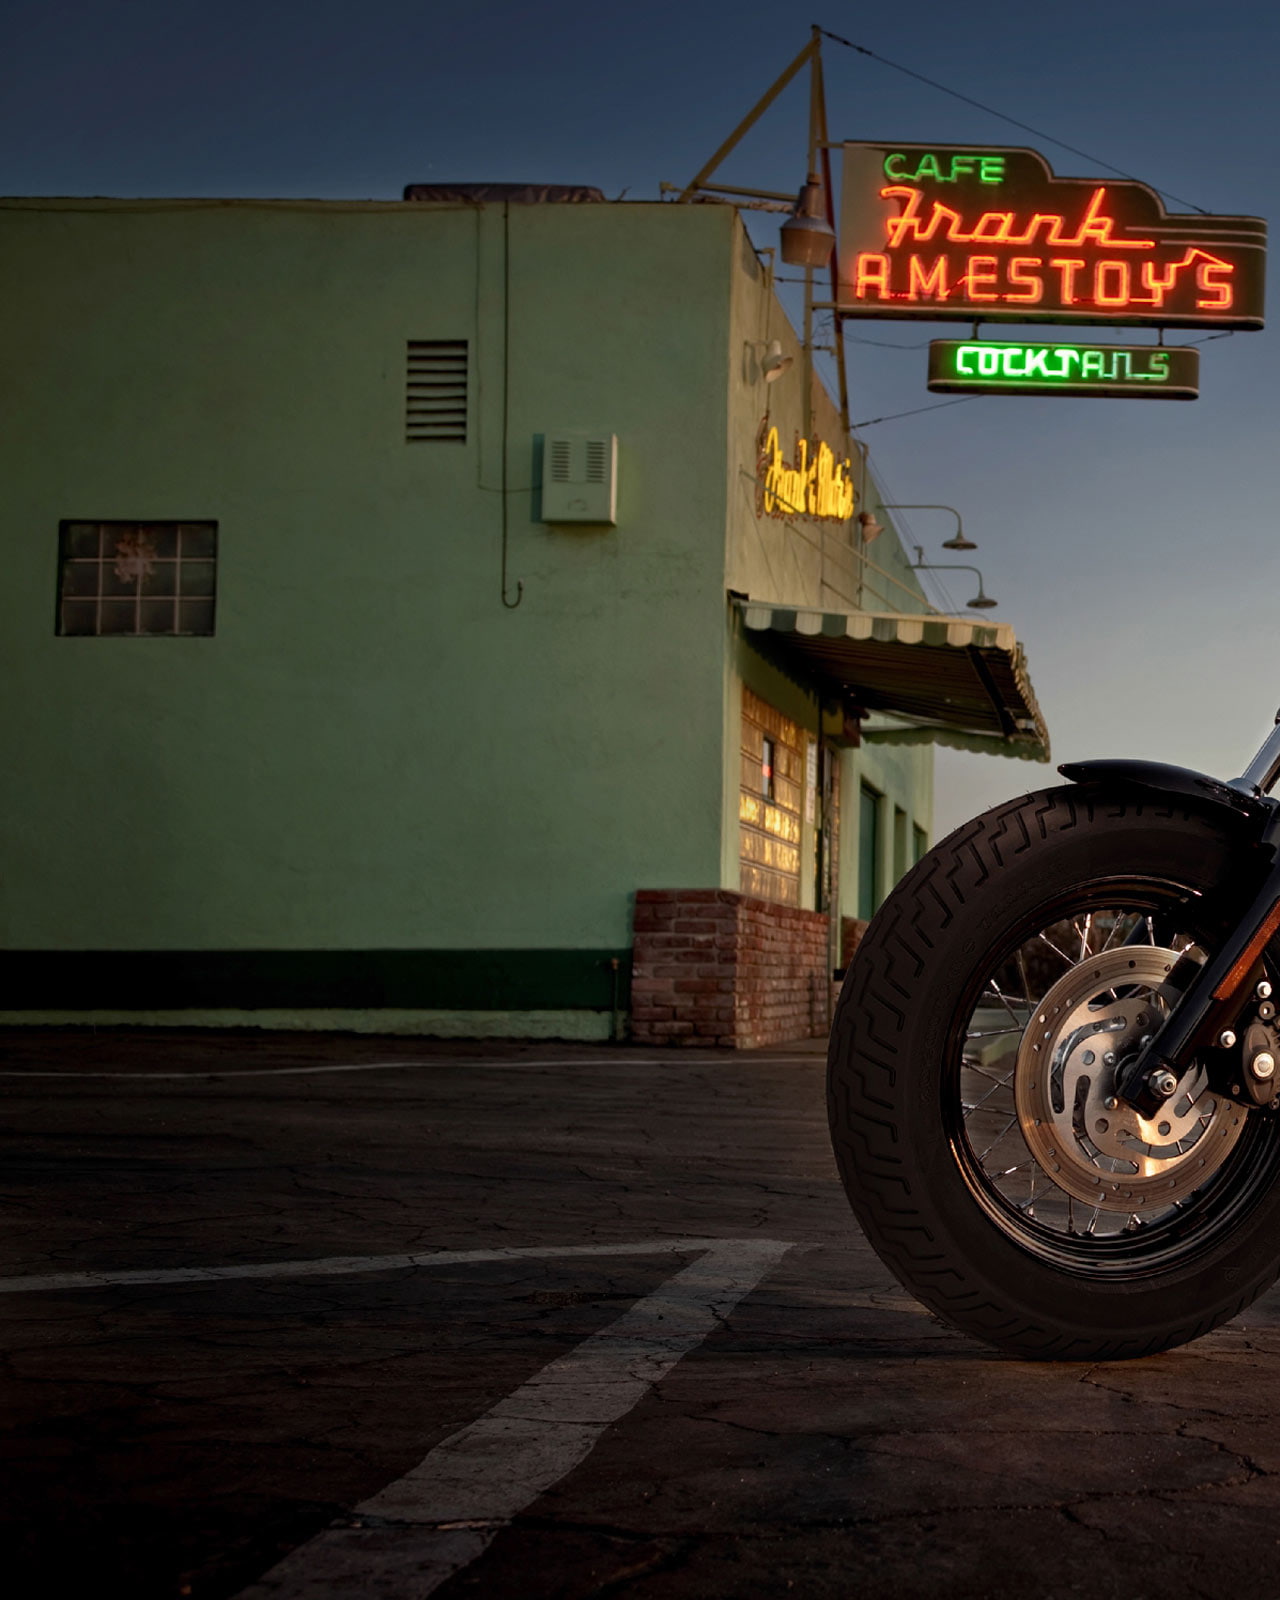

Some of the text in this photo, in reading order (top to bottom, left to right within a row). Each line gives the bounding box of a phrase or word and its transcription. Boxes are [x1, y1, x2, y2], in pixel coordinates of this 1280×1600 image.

[883, 153, 1006, 183] CAFE
[879, 186, 1155, 248] Frank
[855, 247, 1234, 308] AMESTOY'S
[955, 345, 1170, 381] COCKTAILS
